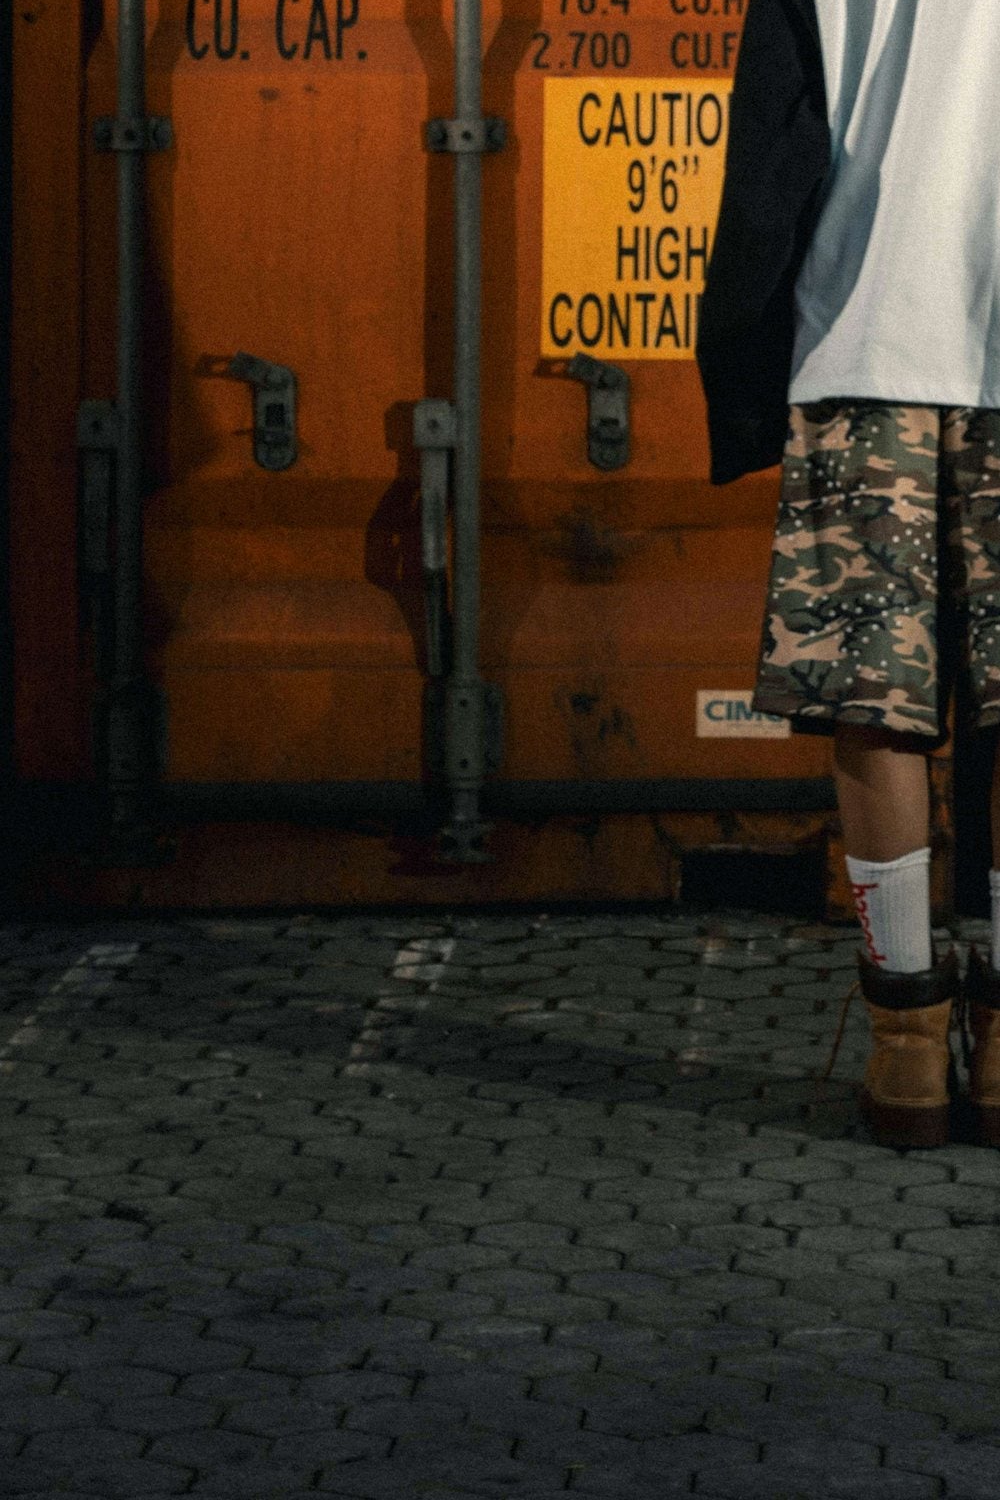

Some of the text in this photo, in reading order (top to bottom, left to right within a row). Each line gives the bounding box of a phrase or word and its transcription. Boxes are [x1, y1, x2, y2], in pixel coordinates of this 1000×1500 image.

[531, 31, 632, 70] 2.700
[578, 91, 733, 147] CAUTIO
[616, 225, 708, 282] HIGH
[549, 292, 703, 349] CONTAI
